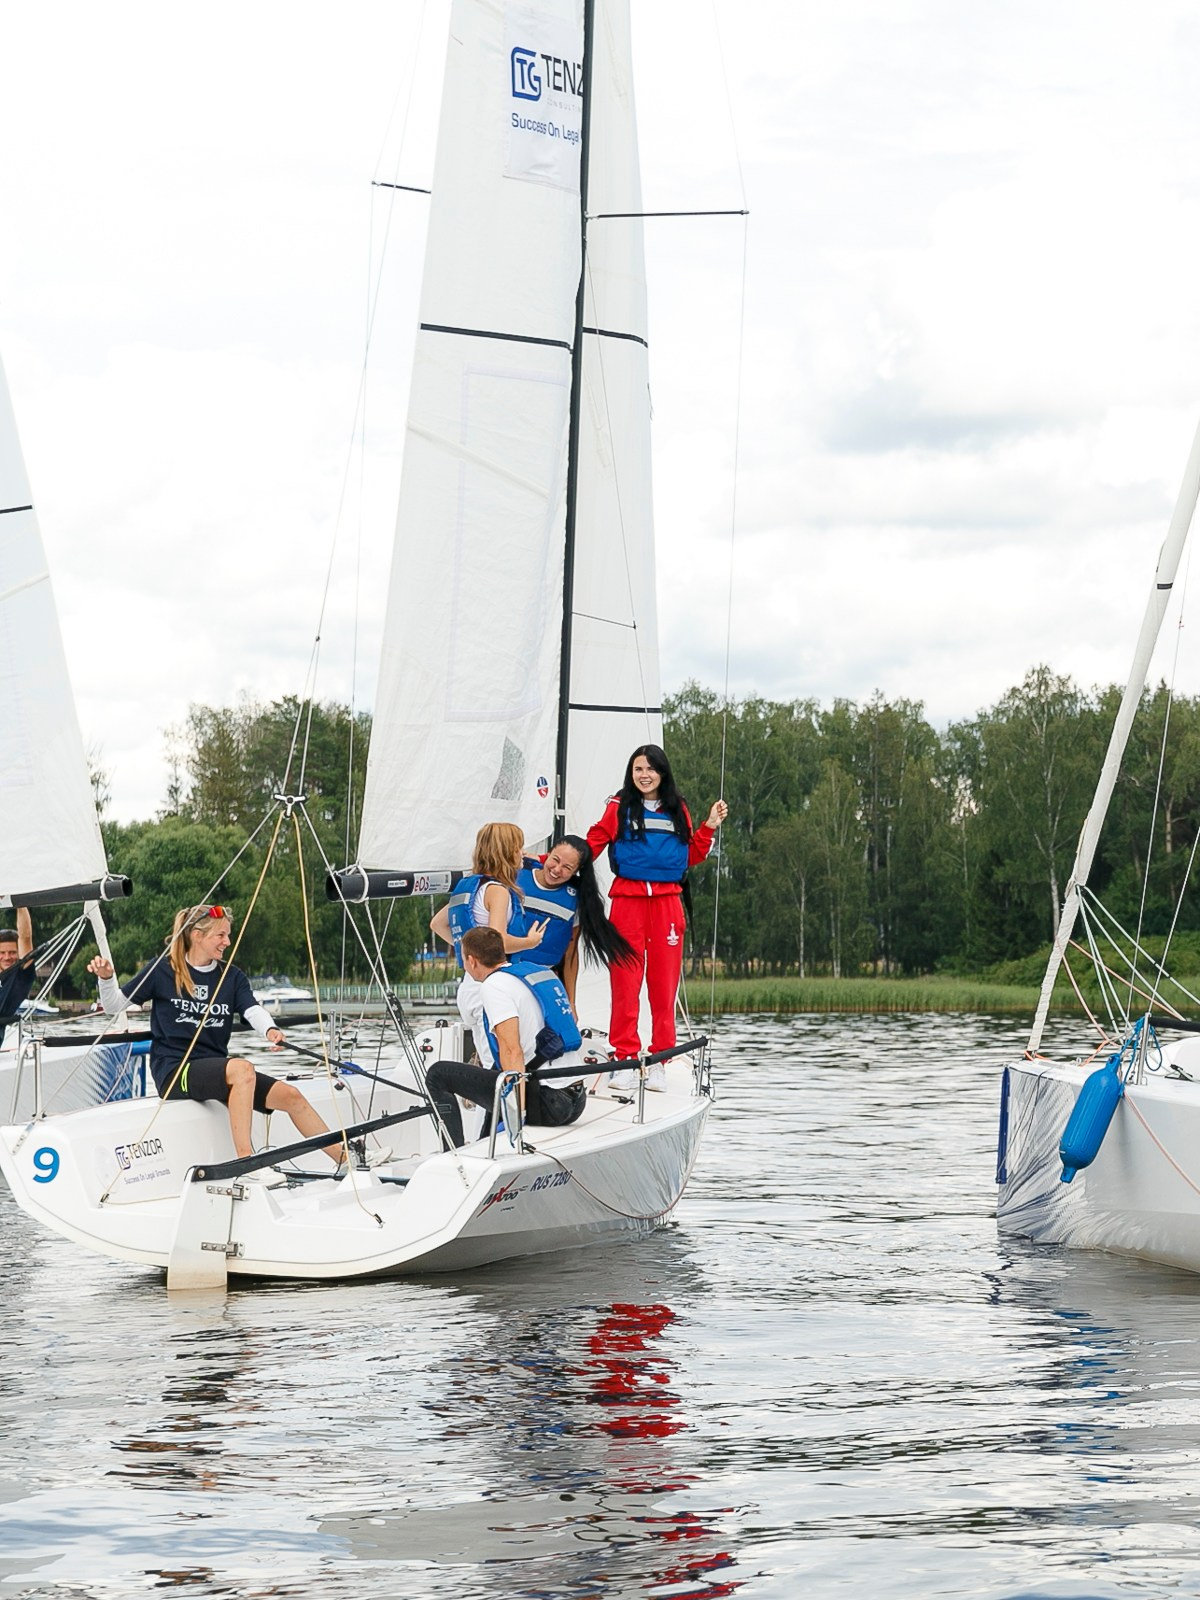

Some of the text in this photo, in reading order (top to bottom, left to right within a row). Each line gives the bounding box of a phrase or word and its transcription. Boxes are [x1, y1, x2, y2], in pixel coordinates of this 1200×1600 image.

[511, 112, 579, 145] Success On Legal
[170, 998, 230, 1016] TENZOR
[126, 1138, 164, 1161] TENZOR
[32, 1146, 60, 1184] 9
[530, 1174, 553, 1192] RUS
